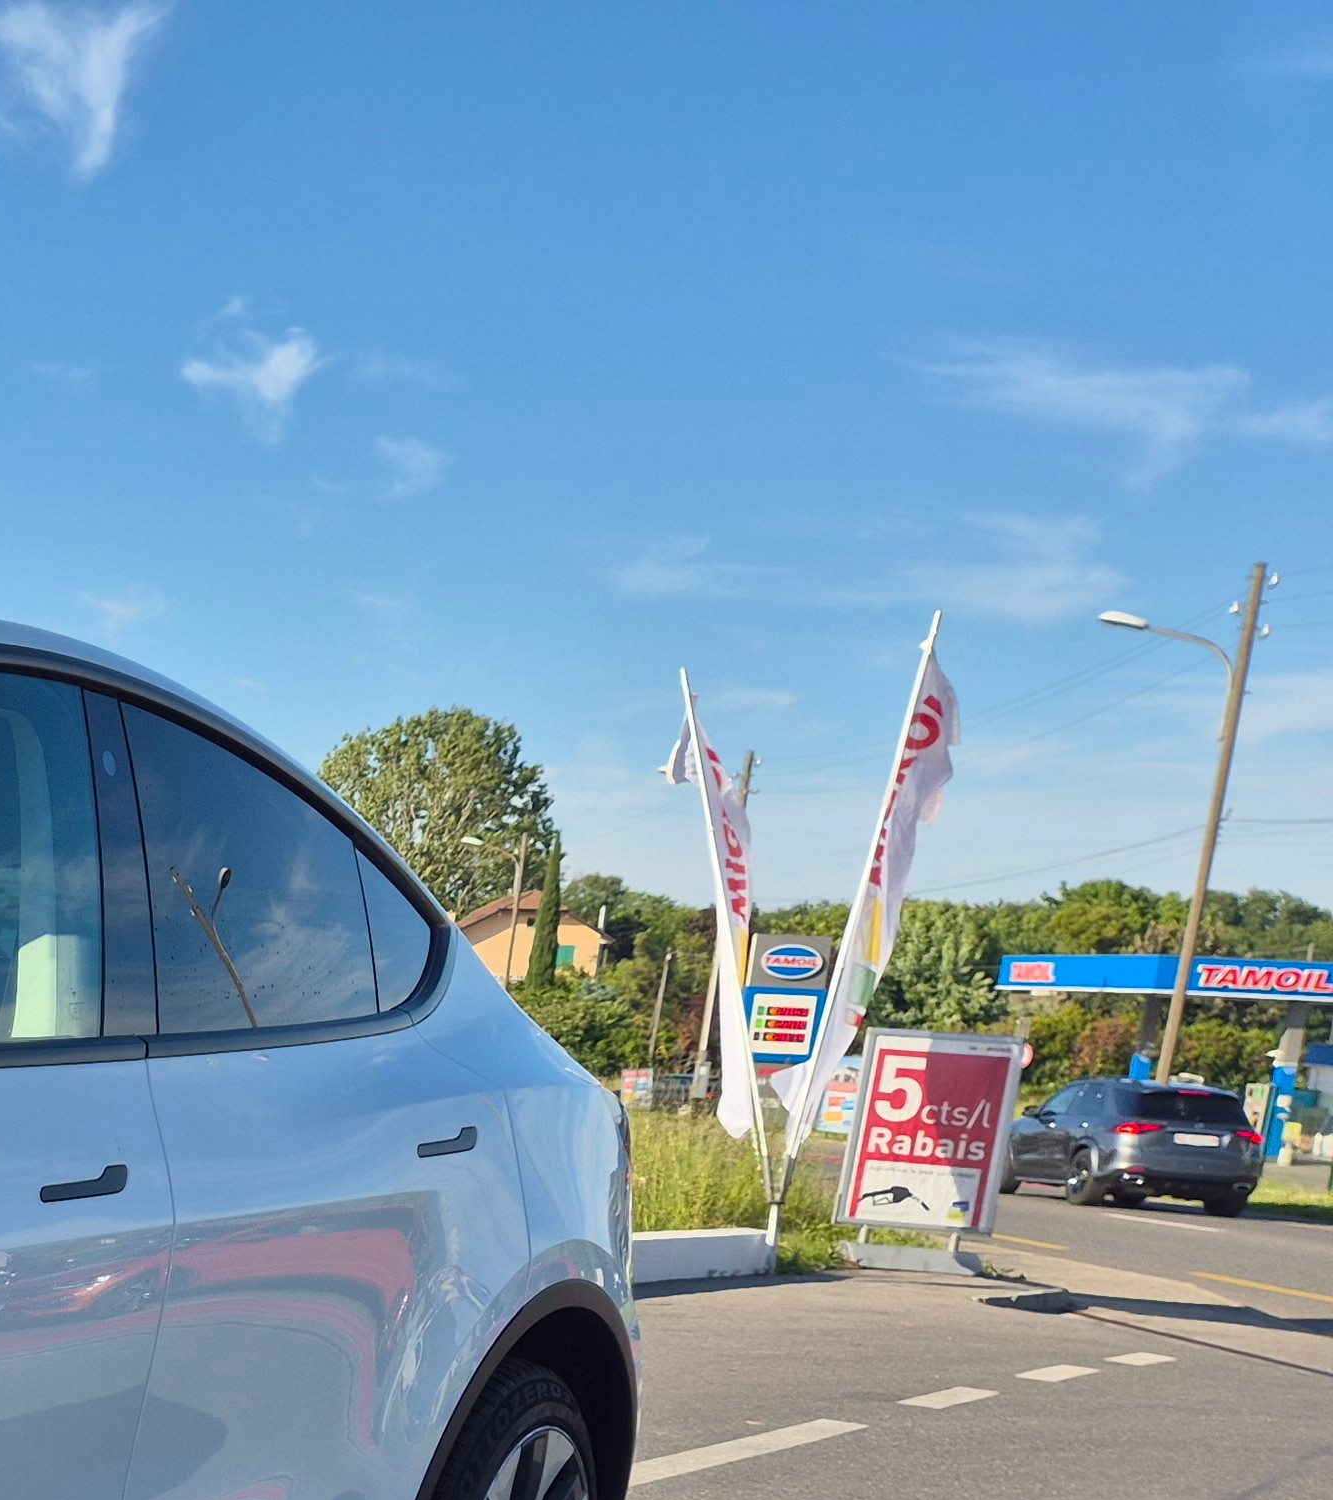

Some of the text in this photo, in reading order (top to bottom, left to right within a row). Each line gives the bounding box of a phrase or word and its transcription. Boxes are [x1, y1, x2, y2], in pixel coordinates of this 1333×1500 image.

[765, 955, 819, 969] TAMOIL
[1198, 964, 1333, 994] TAMOIL
[866, 1126, 987, 1161] Rabais
